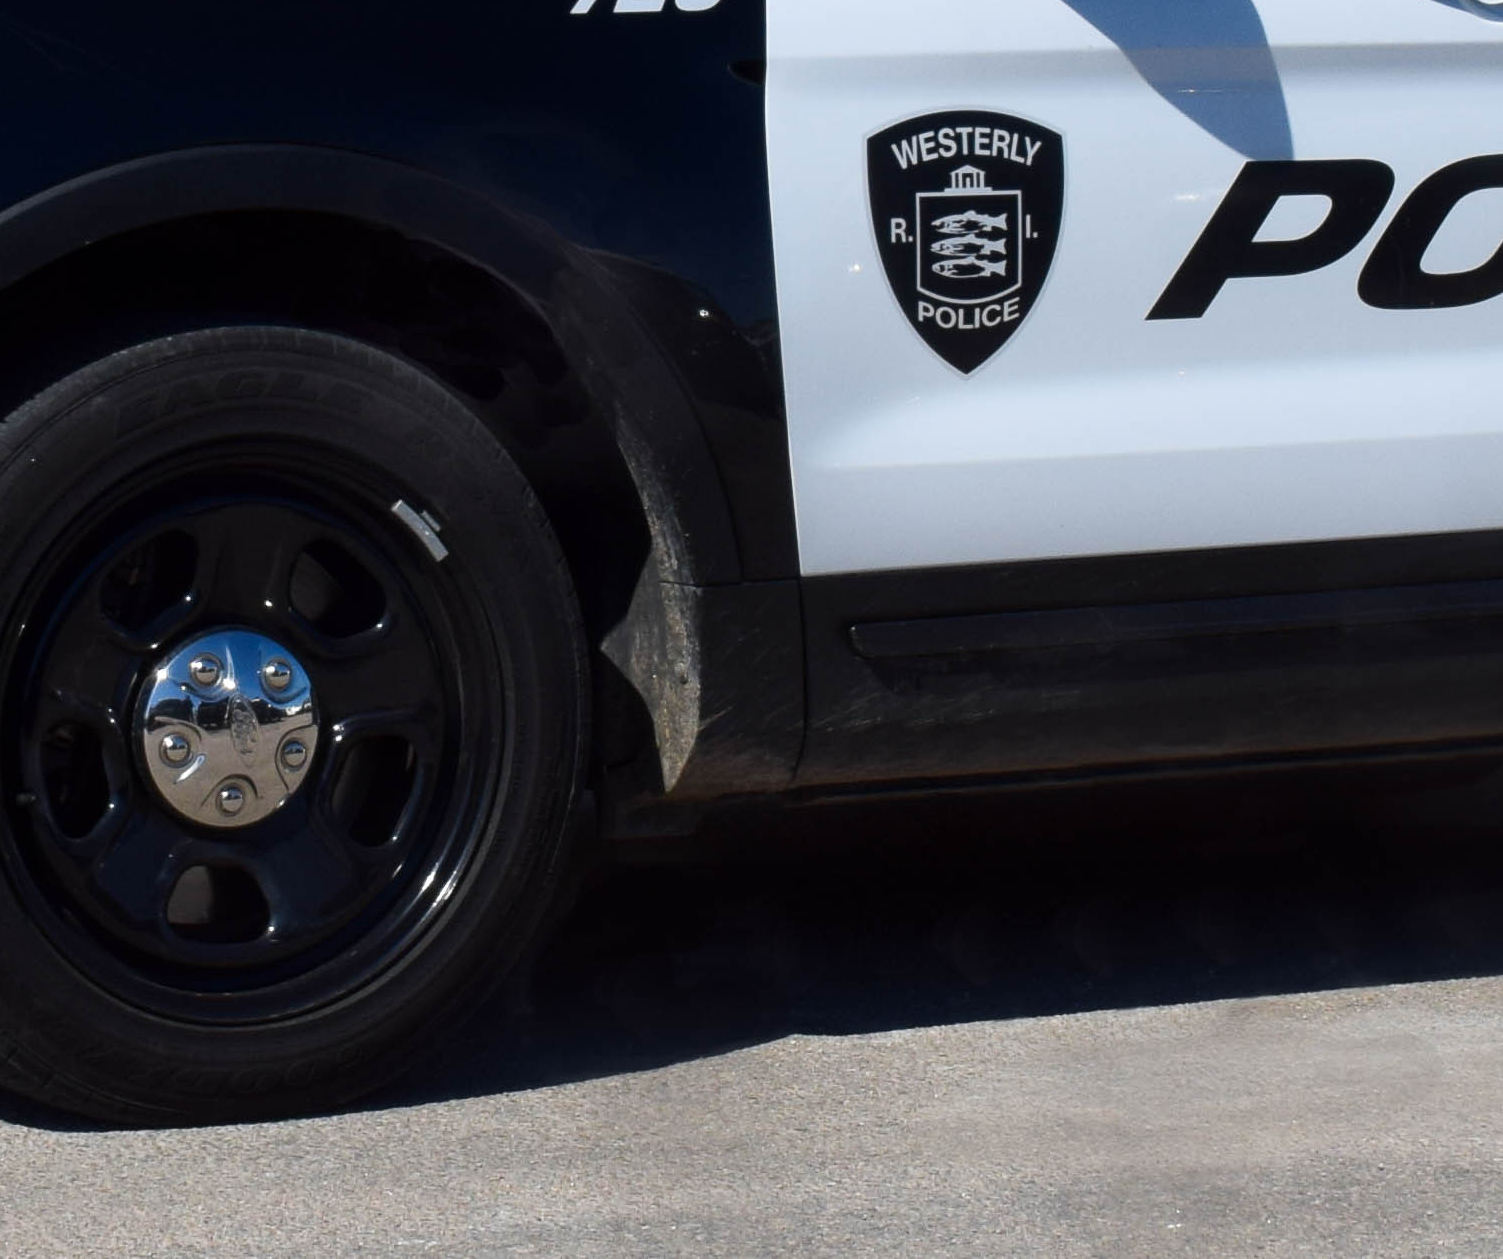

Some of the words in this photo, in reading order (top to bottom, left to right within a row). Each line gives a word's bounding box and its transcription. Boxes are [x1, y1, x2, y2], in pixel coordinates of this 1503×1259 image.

[890, 126, 1043, 170] WESTERLY
[889, 217, 913, 243] R.
[1025, 214, 1039, 239] I.
[917, 296, 1021, 330] POLICE
